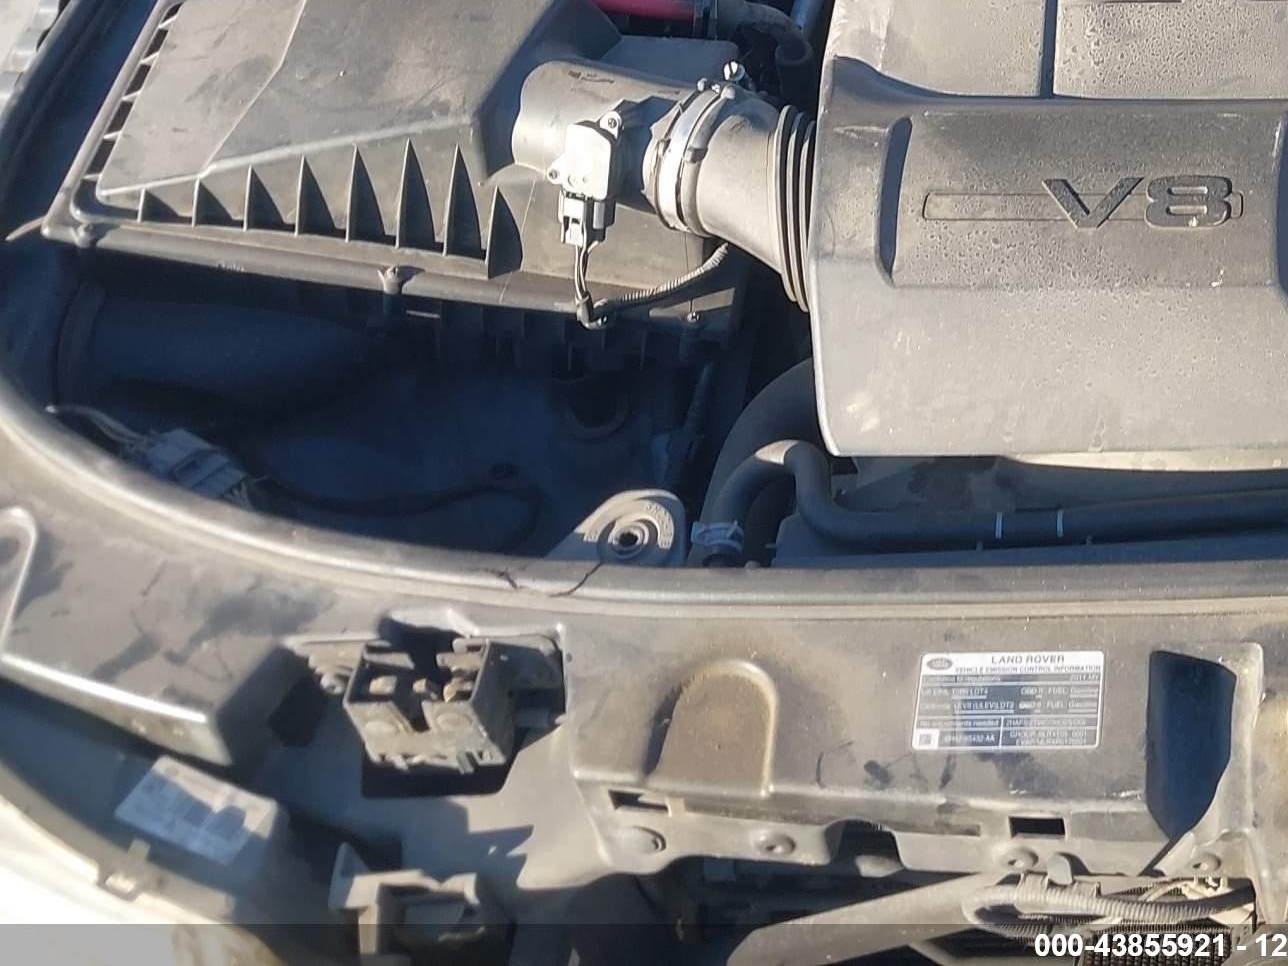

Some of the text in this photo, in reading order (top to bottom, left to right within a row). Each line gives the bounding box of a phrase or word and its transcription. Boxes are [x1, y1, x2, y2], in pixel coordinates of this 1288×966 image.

[1042, 174, 1233, 229] V8
[991, 654, 1064, 664] LAND ROVER
